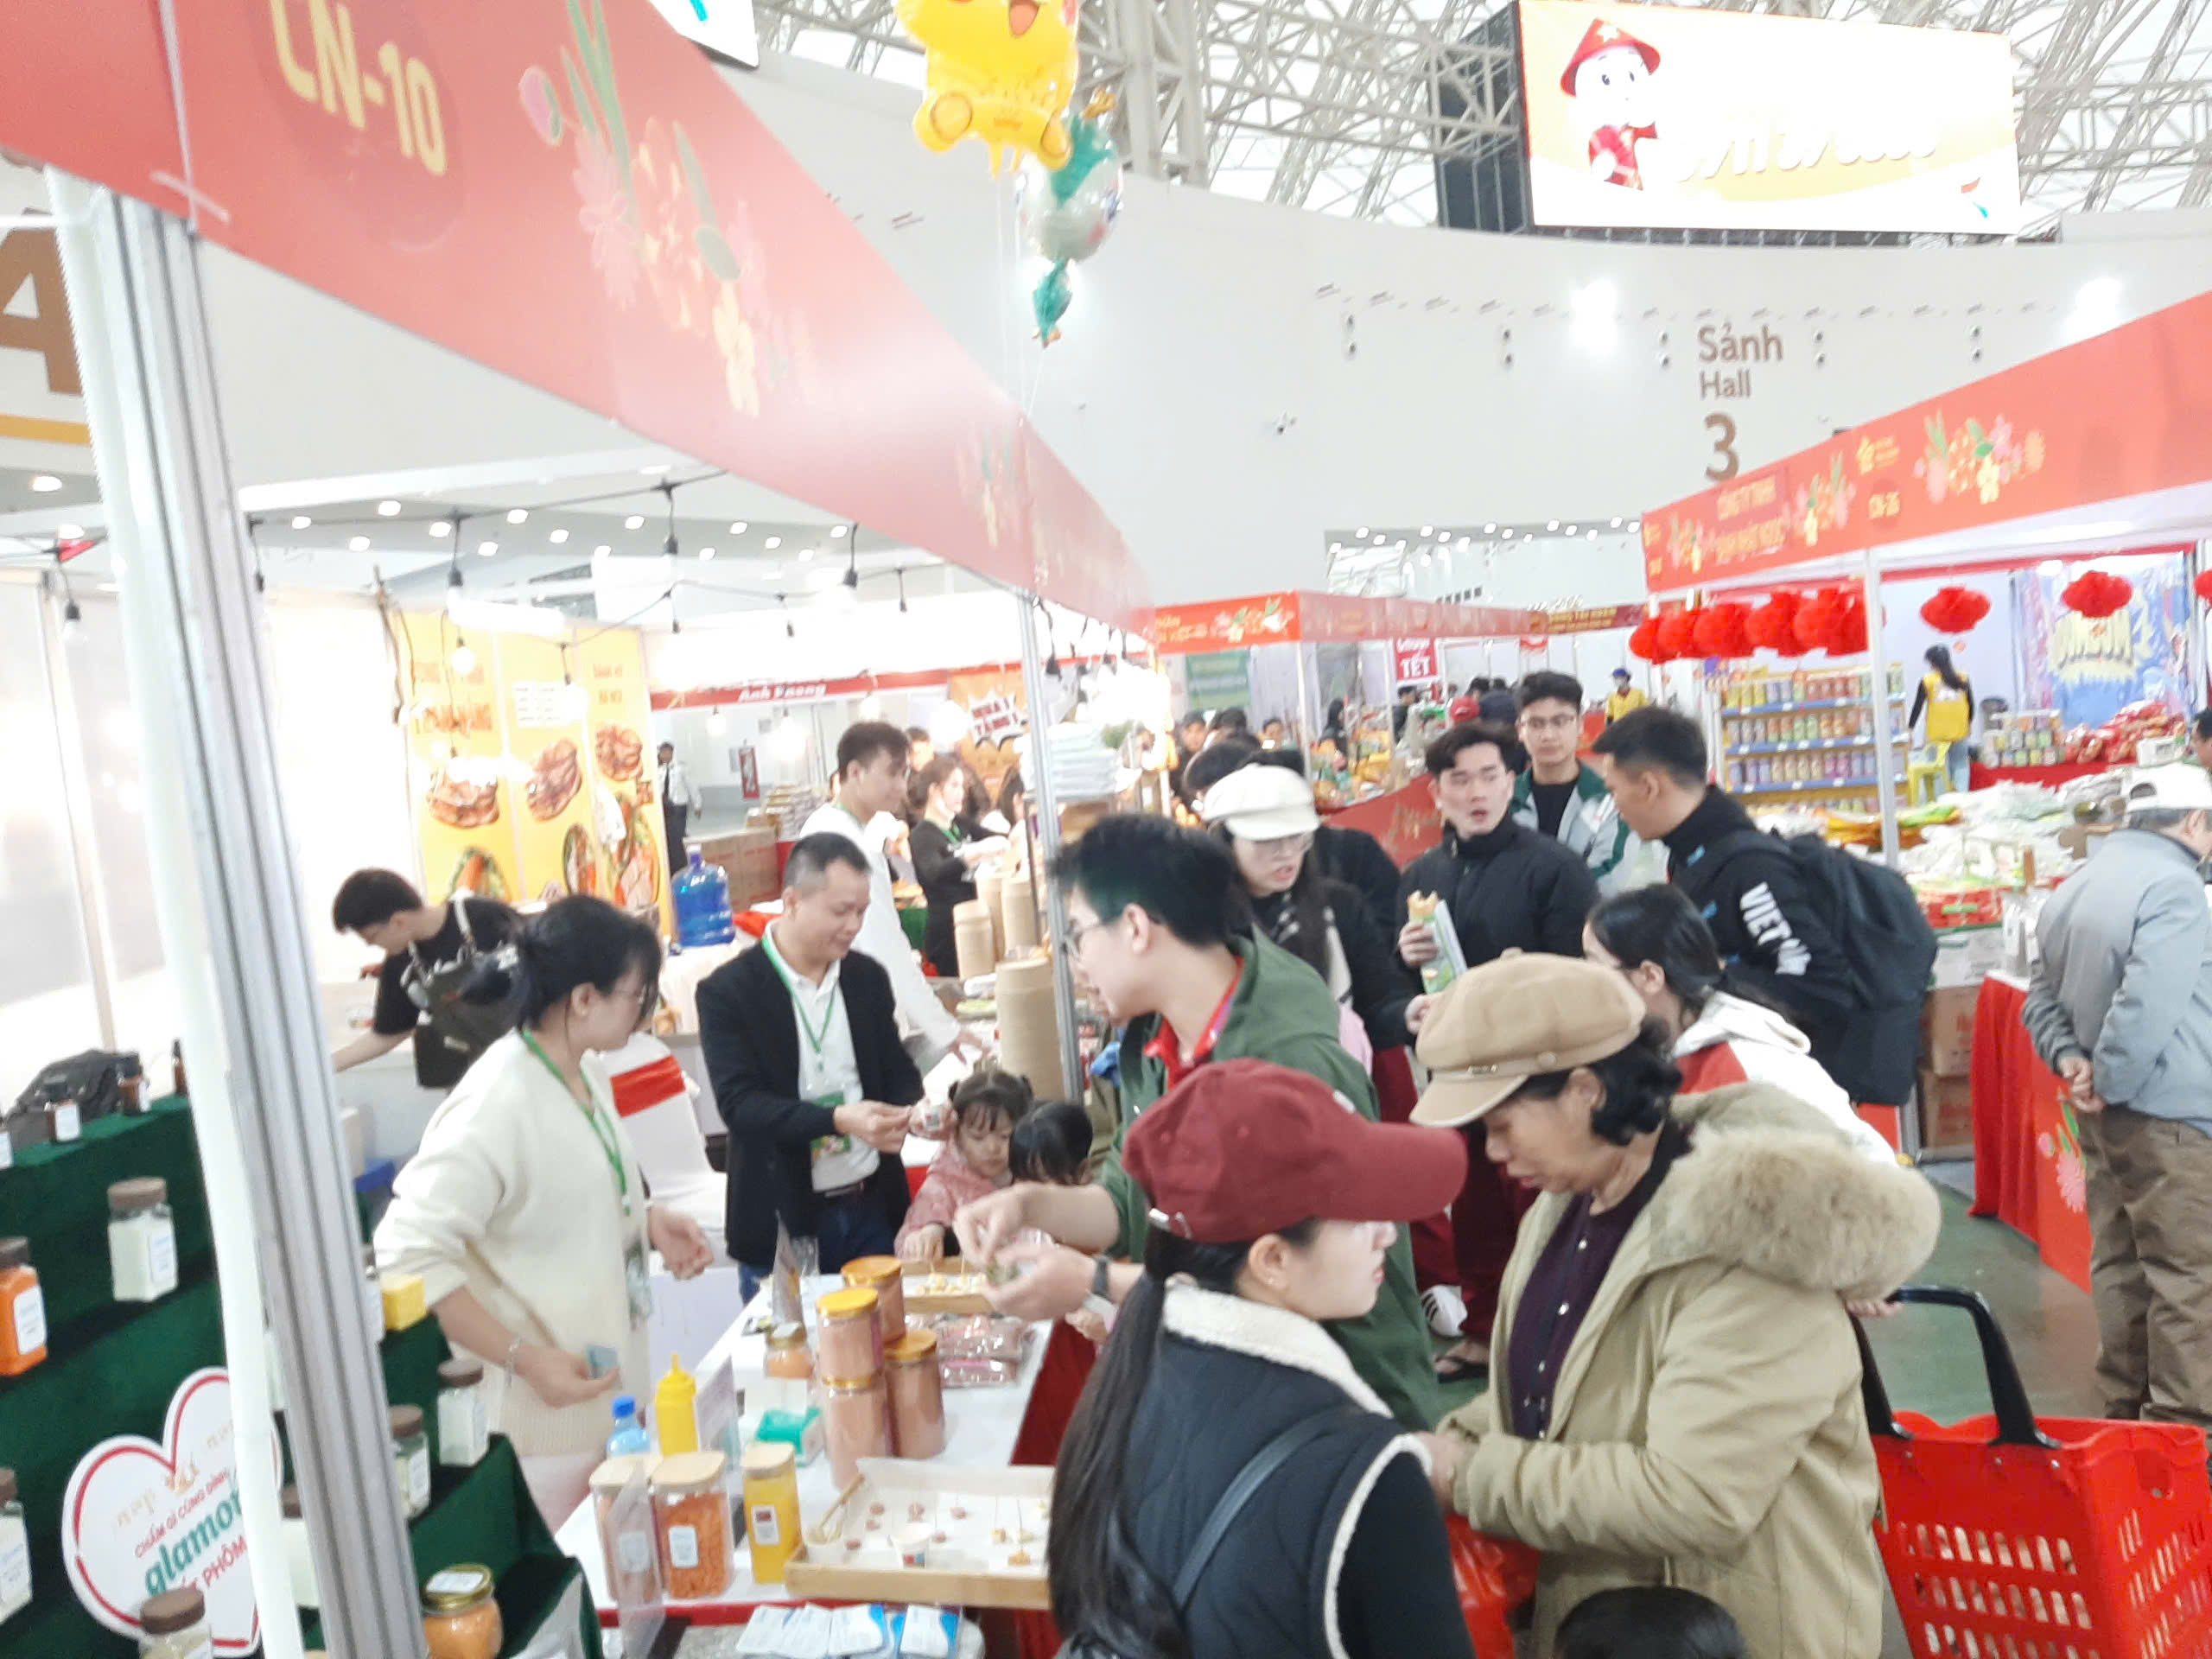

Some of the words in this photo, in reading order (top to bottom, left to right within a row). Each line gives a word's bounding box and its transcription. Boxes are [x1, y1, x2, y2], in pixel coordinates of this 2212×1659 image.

[1698, 321, 1783, 363] Sảnh
[1699, 368, 1751, 399] Hall
[1704, 412, 1740, 482] 3
